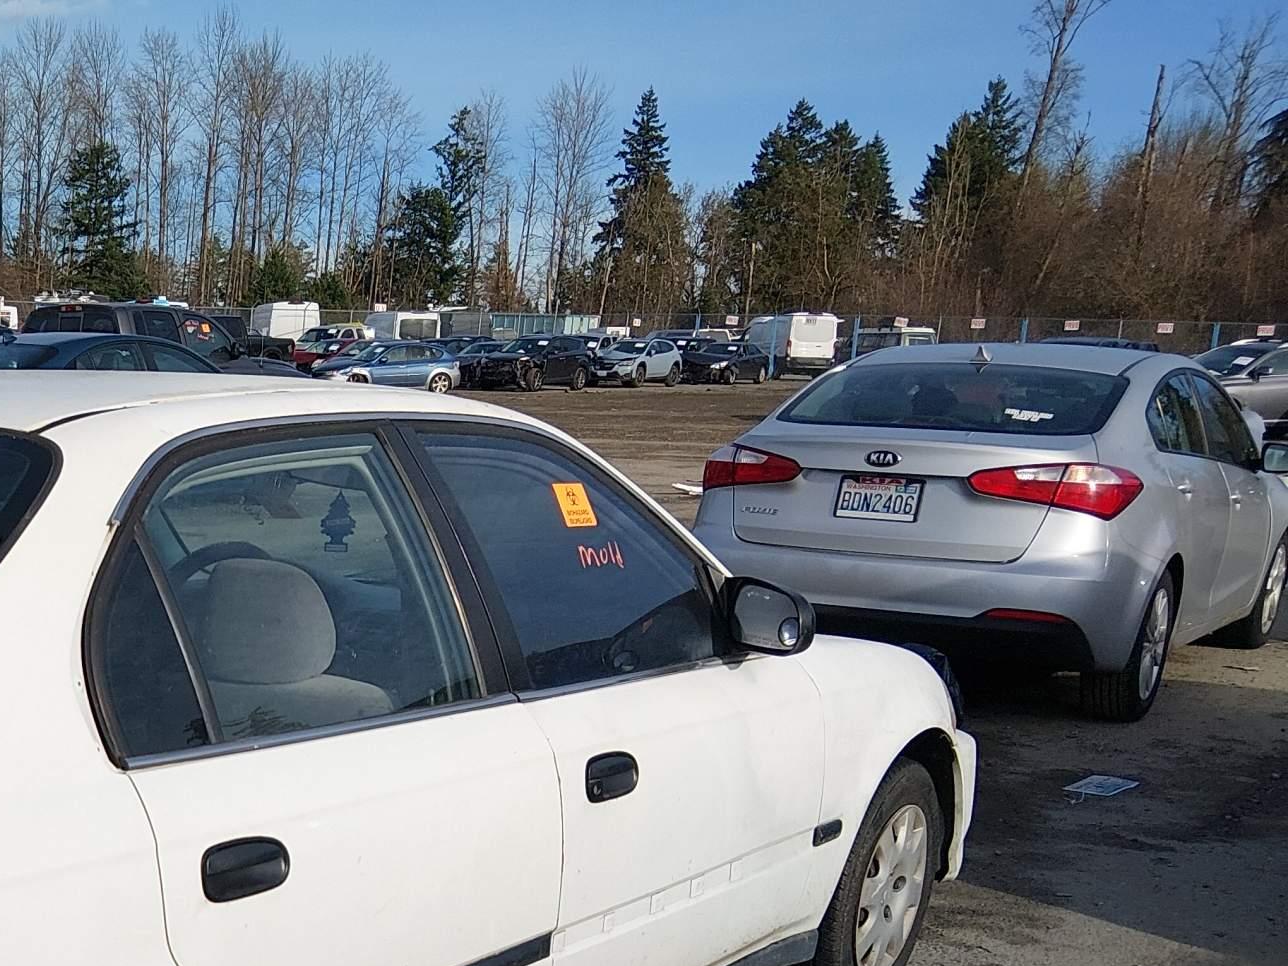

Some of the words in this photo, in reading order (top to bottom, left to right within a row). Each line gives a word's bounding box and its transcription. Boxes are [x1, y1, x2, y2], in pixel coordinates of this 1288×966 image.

[869, 452, 894, 464] KIA
[846, 482, 892, 492] WASHINGTON
[840, 491, 915, 515] BDN2406
